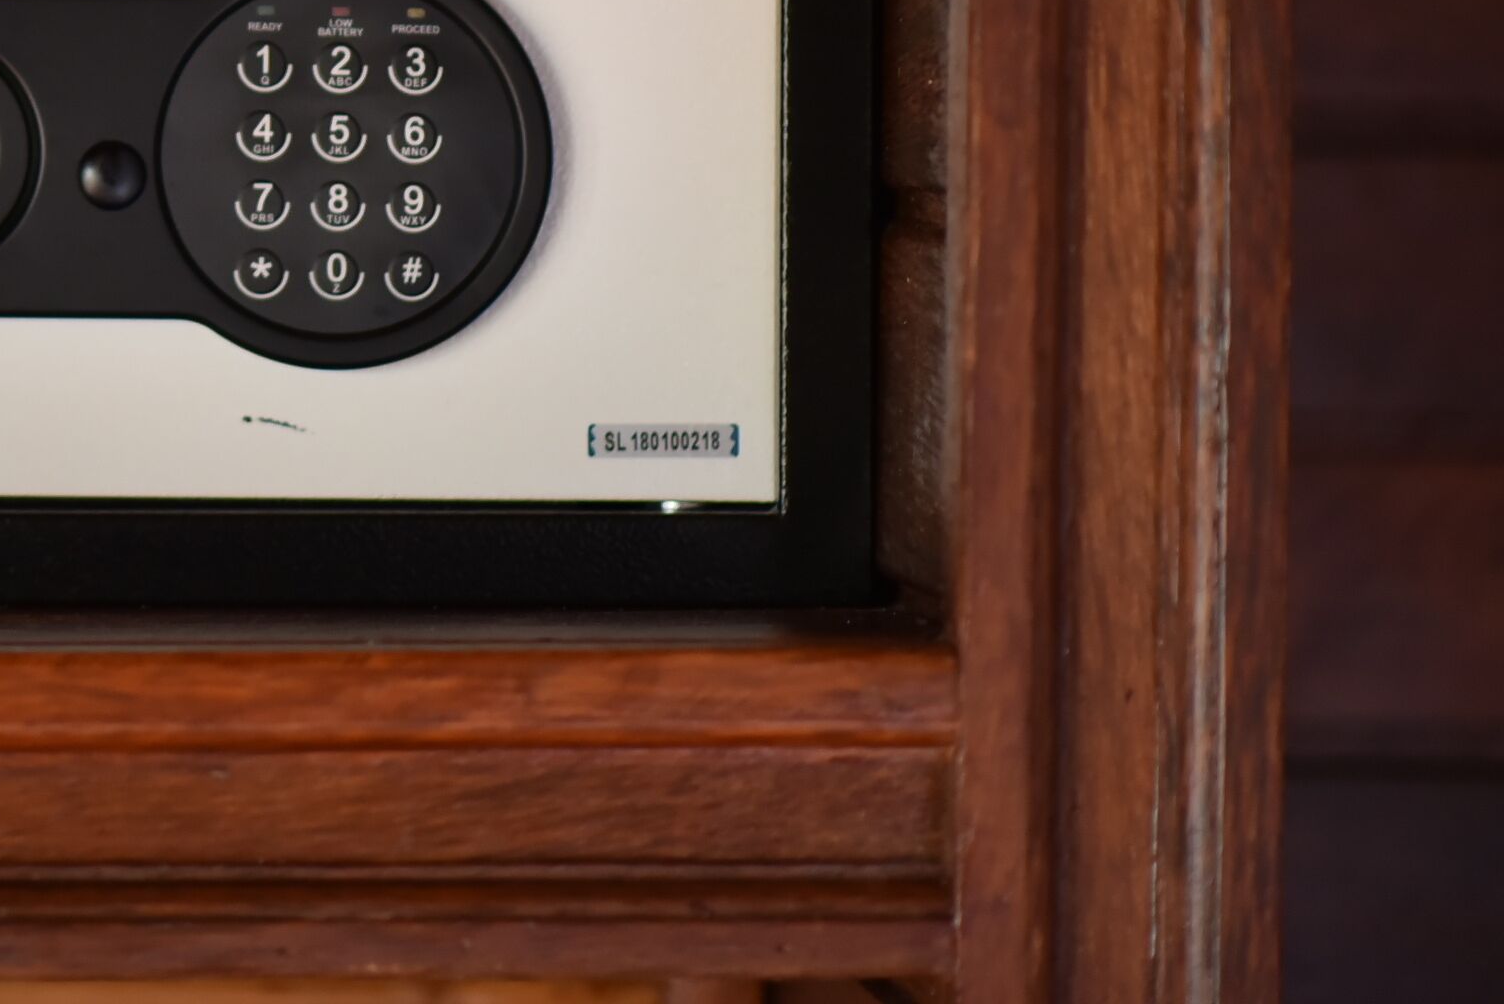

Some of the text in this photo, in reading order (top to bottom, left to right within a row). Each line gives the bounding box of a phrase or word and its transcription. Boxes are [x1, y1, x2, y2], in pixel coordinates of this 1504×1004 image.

[248, 22, 283, 31] READY
[329, 19, 353, 28] LOW
[317, 28, 363, 37] BATTERY
[392, 25, 440, 34] PROCEED
[256, 45, 270, 74] 1
[331, 46, 350, 76] 2
[406, 47, 426, 76] 3
[328, 77, 352, 87] ABC
[405, 78, 428, 88] DEF
[253, 114, 274, 142] 4
[329, 116, 349, 144] 5
[404, 117, 424, 145] 6
[253, 144, 274, 154] GHI
[328, 146, 349, 155] JKL
[402, 147, 428, 157] MNO
[253, 184, 273, 211] 7
[328, 184, 348, 213] 8
[403, 186, 423, 214] 9
[251, 213, 274, 223] PRS
[327, 214, 350, 224] TUV
[400, 216, 426, 225] WXY
[327, 253, 347, 282] 0
